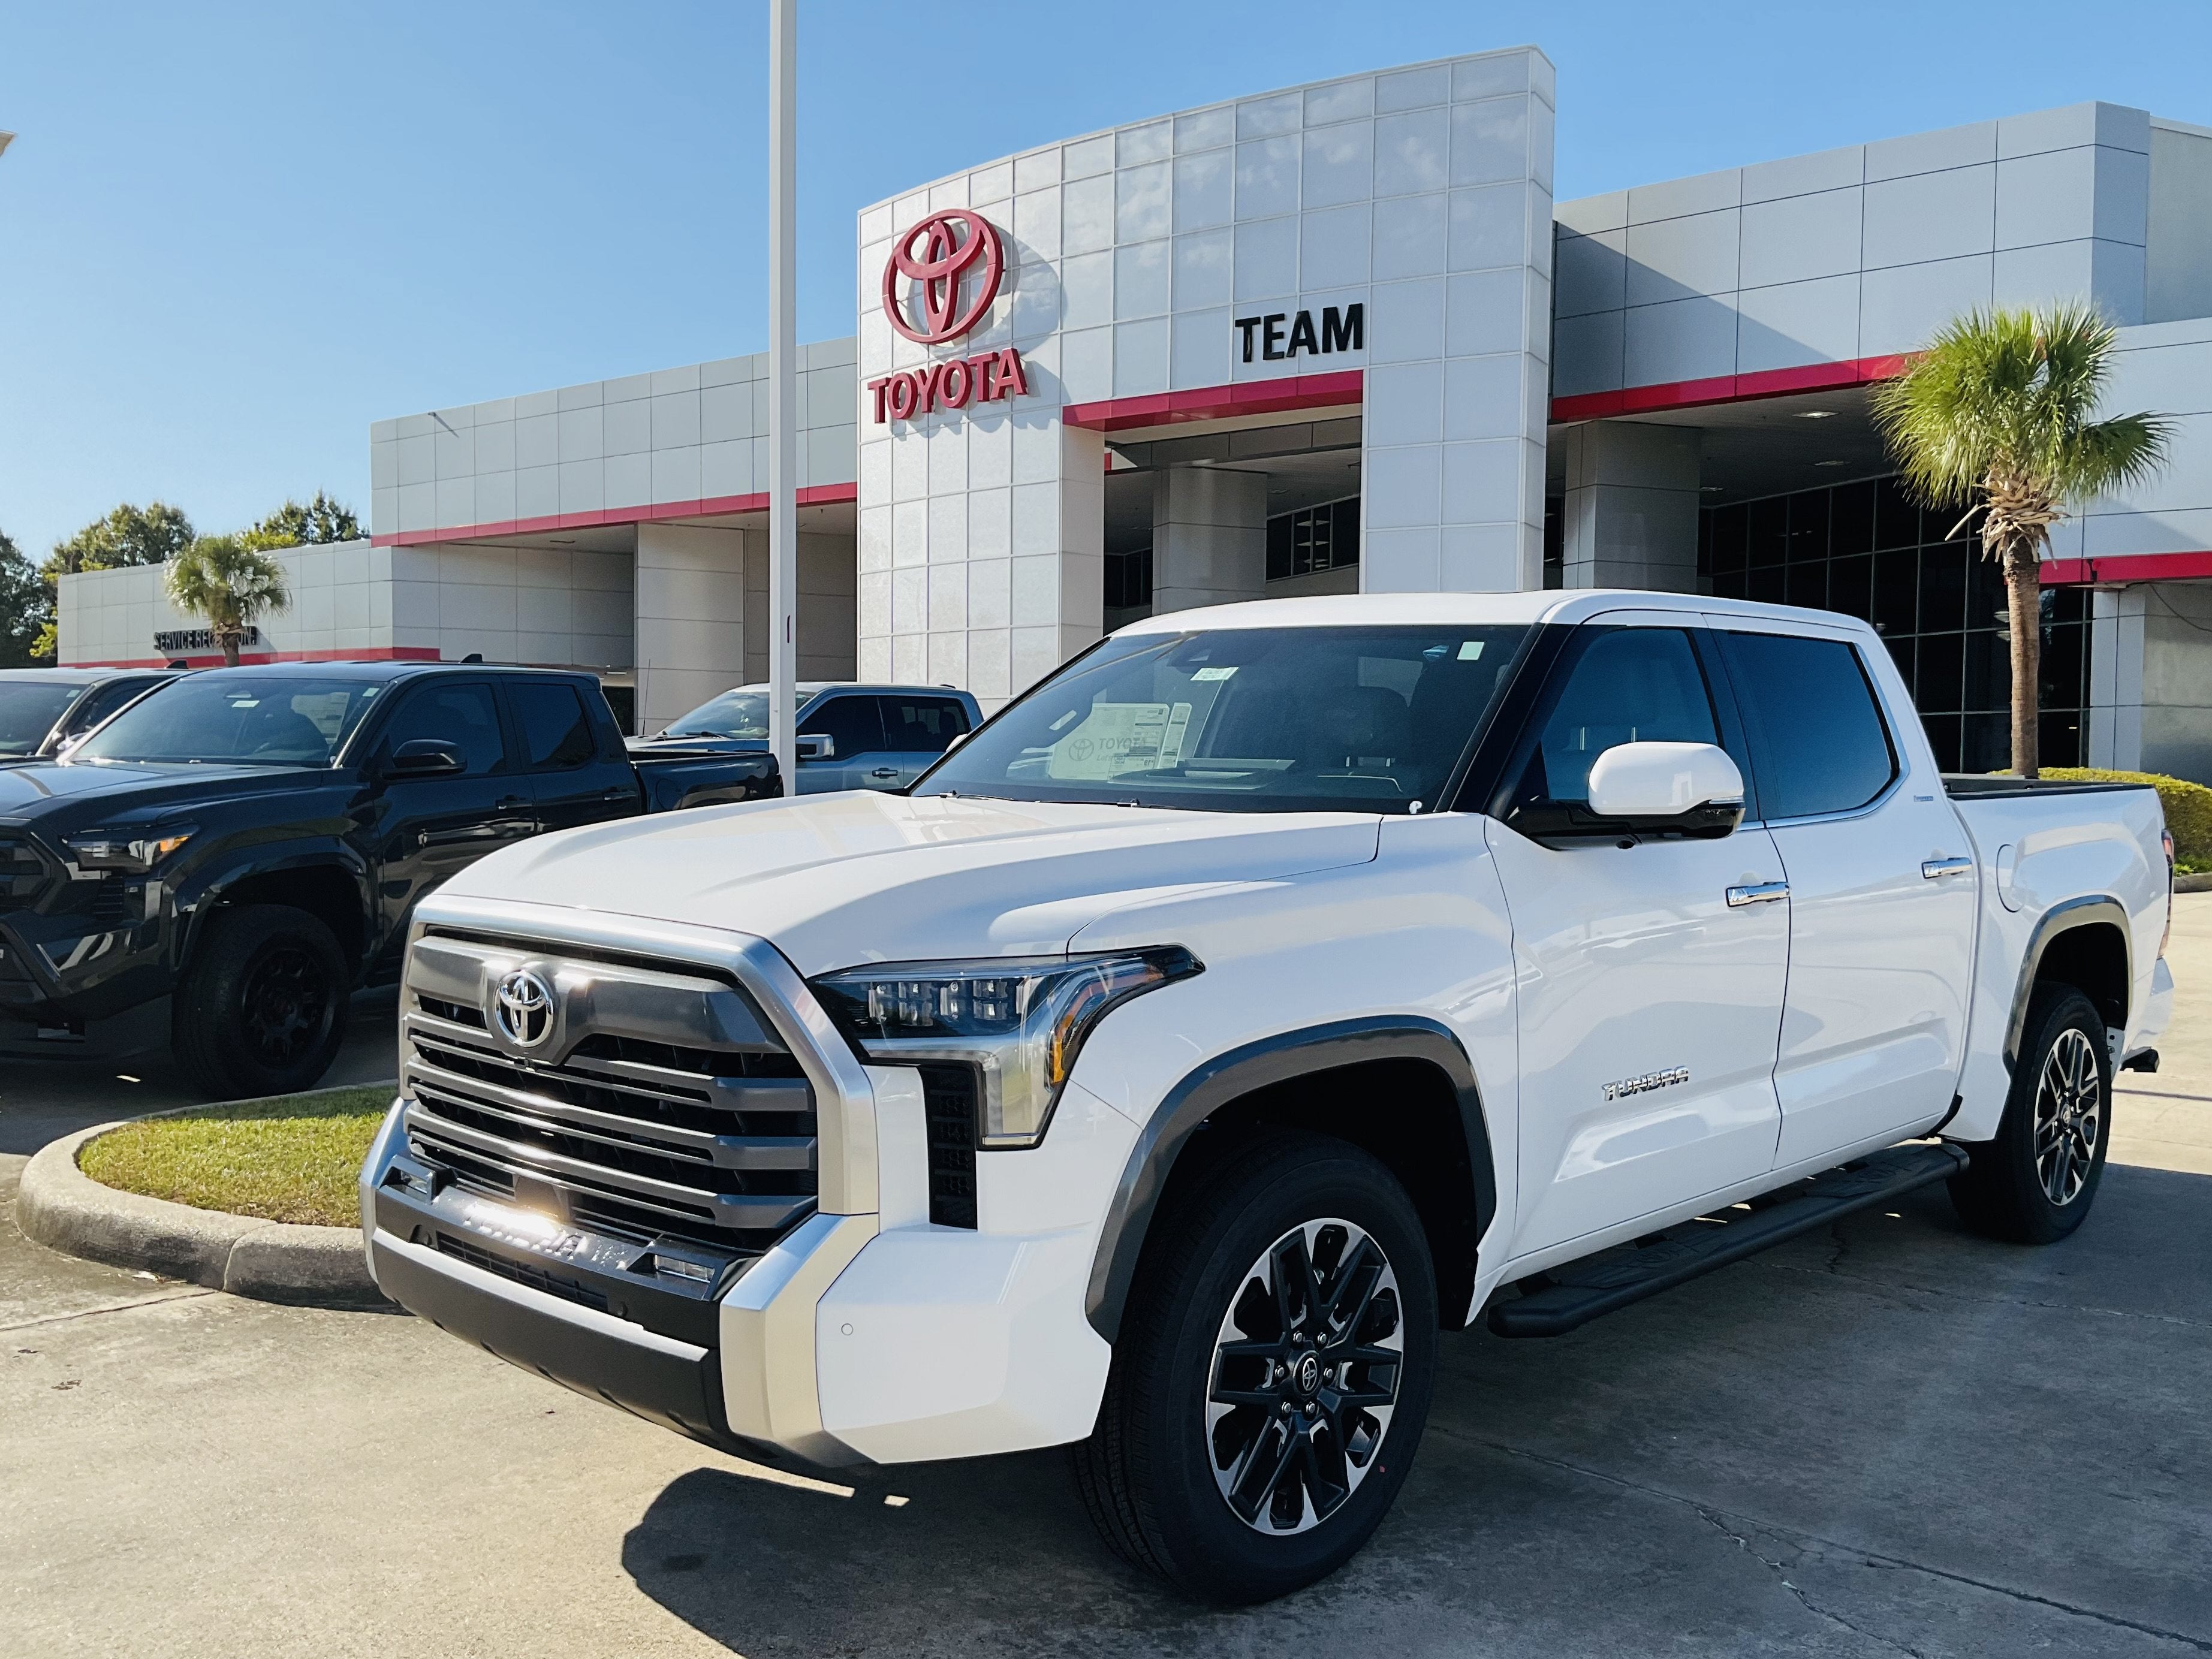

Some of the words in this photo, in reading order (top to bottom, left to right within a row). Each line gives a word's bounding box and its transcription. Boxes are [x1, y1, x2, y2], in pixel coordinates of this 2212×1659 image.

[1235, 303, 1363, 363] TEAM
[867, 347, 1029, 424] TOYOTA
[154, 631, 193, 650] SERVICE
[1601, 1066, 1689, 1101] TUNDRA
